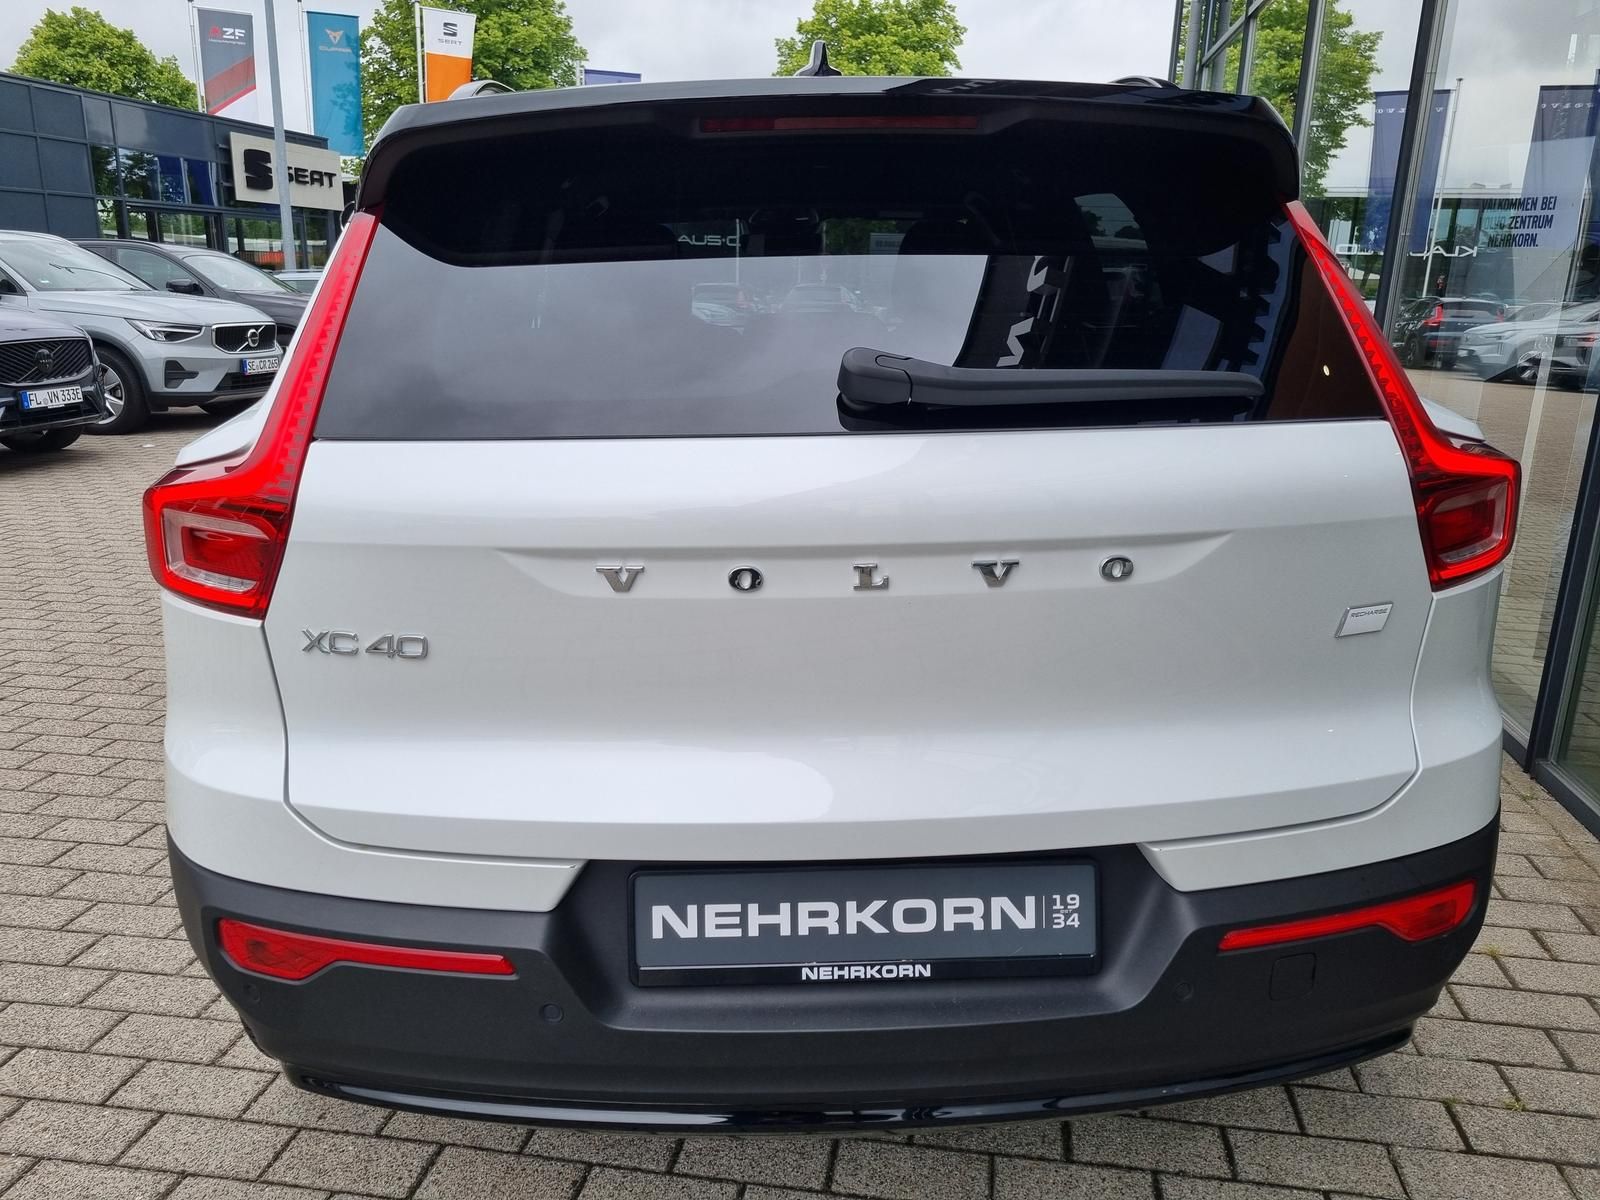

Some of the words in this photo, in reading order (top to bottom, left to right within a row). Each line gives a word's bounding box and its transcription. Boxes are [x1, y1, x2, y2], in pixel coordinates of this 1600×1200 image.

[1540, 195, 1558, 211] BEI
[1508, 214, 1555, 230] ZENTRUM
[1487, 233, 1539, 248] NEHRKORN.
[28, 392, 42, 406] FL
[47, 389, 60, 403] VN
[60, 387, 82, 402] 333E
[596, 553, 1135, 593] VOLVO
[1052, 894, 1080, 909] 19
[651, 895, 1036, 939] NEHRKORN
[1052, 913, 1080, 928] 34
[801, 964, 931, 980] NEHRKORN
